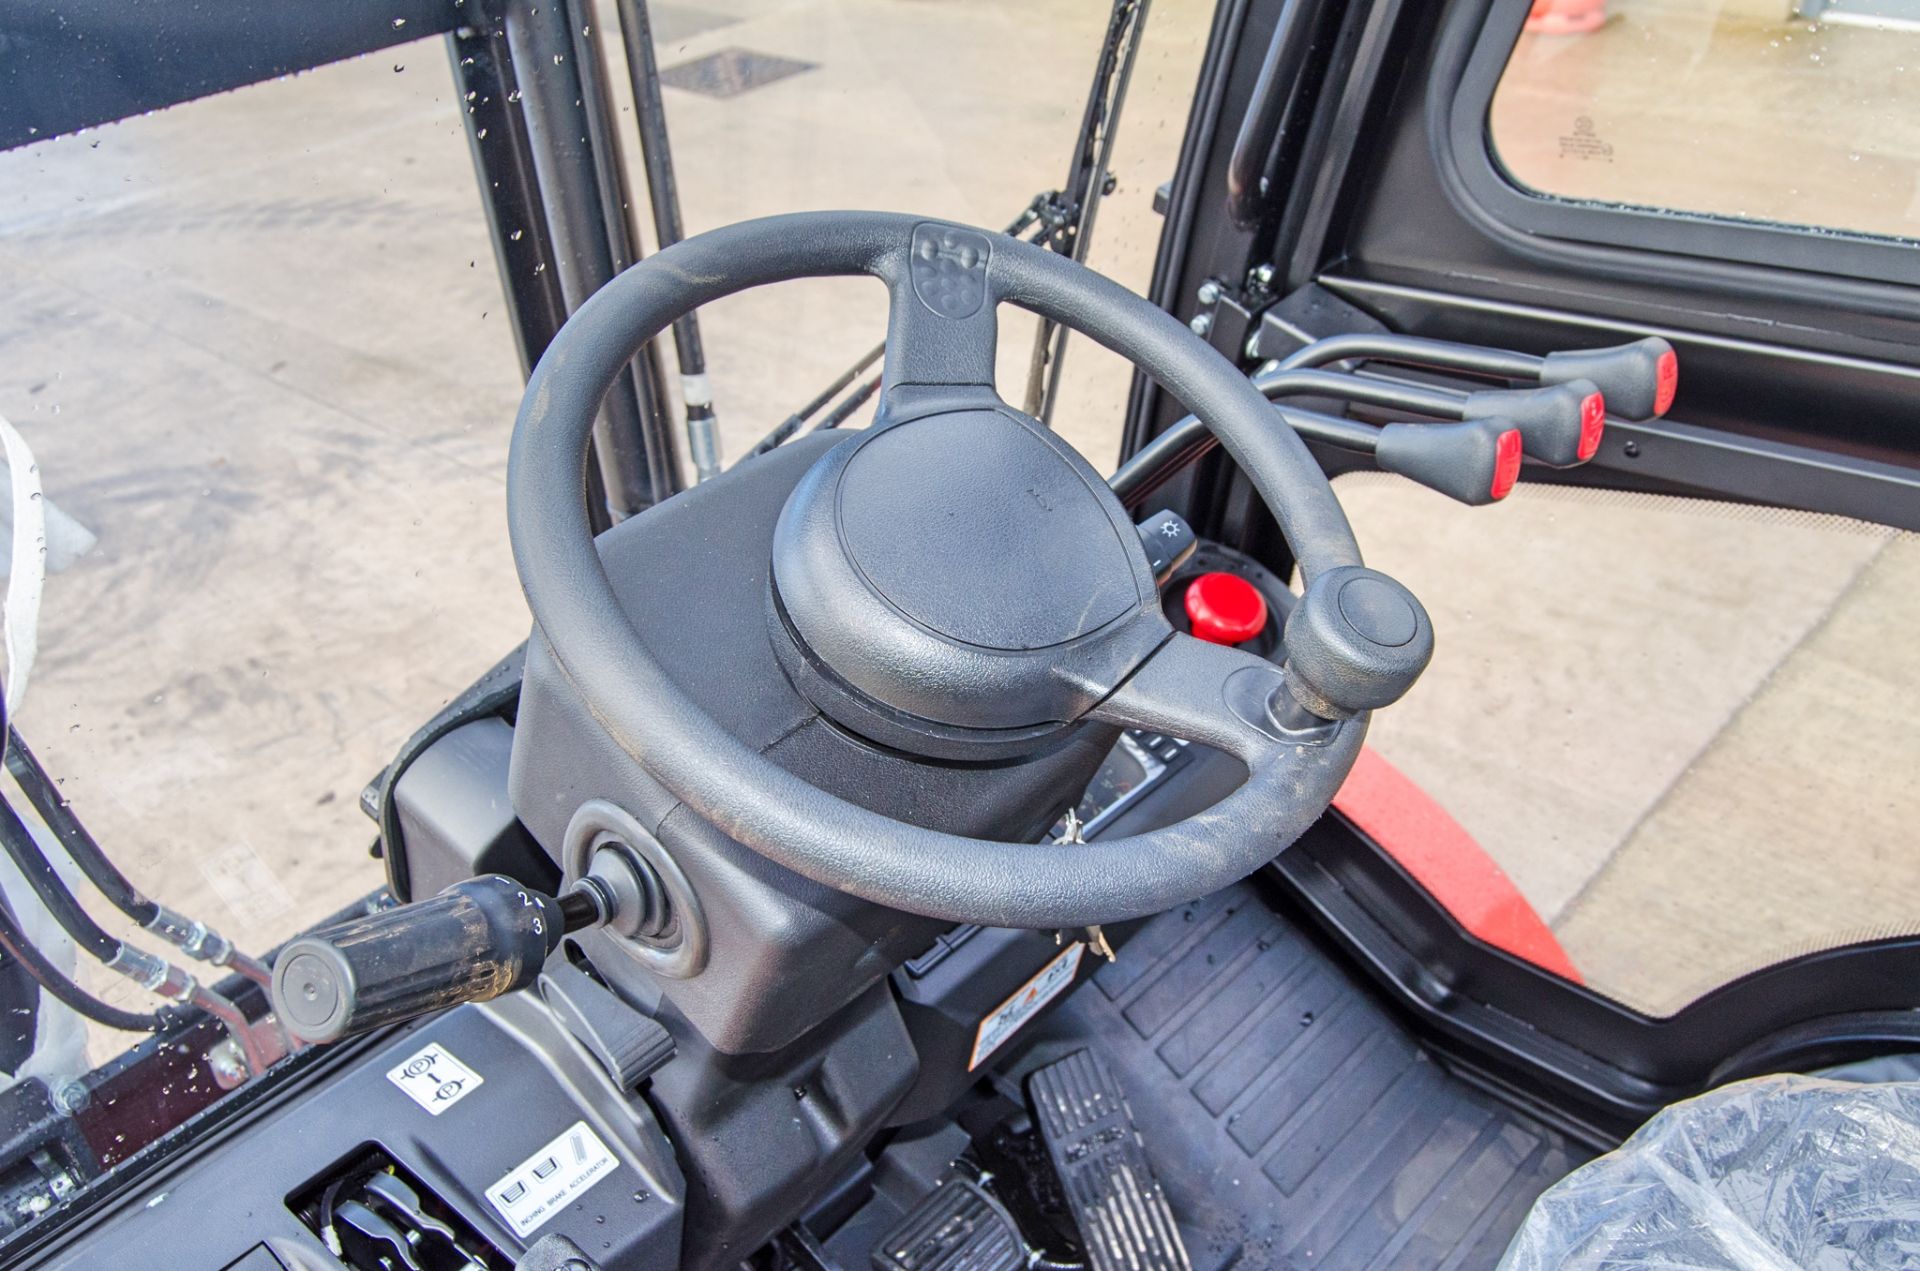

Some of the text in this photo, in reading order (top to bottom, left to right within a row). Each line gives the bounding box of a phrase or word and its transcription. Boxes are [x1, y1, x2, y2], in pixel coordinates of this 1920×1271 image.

[518, 892, 532, 906] 2
[533, 918, 542, 934] 3
[520, 1157, 608, 1227] INCHING BRAKE ACCELERATOR
